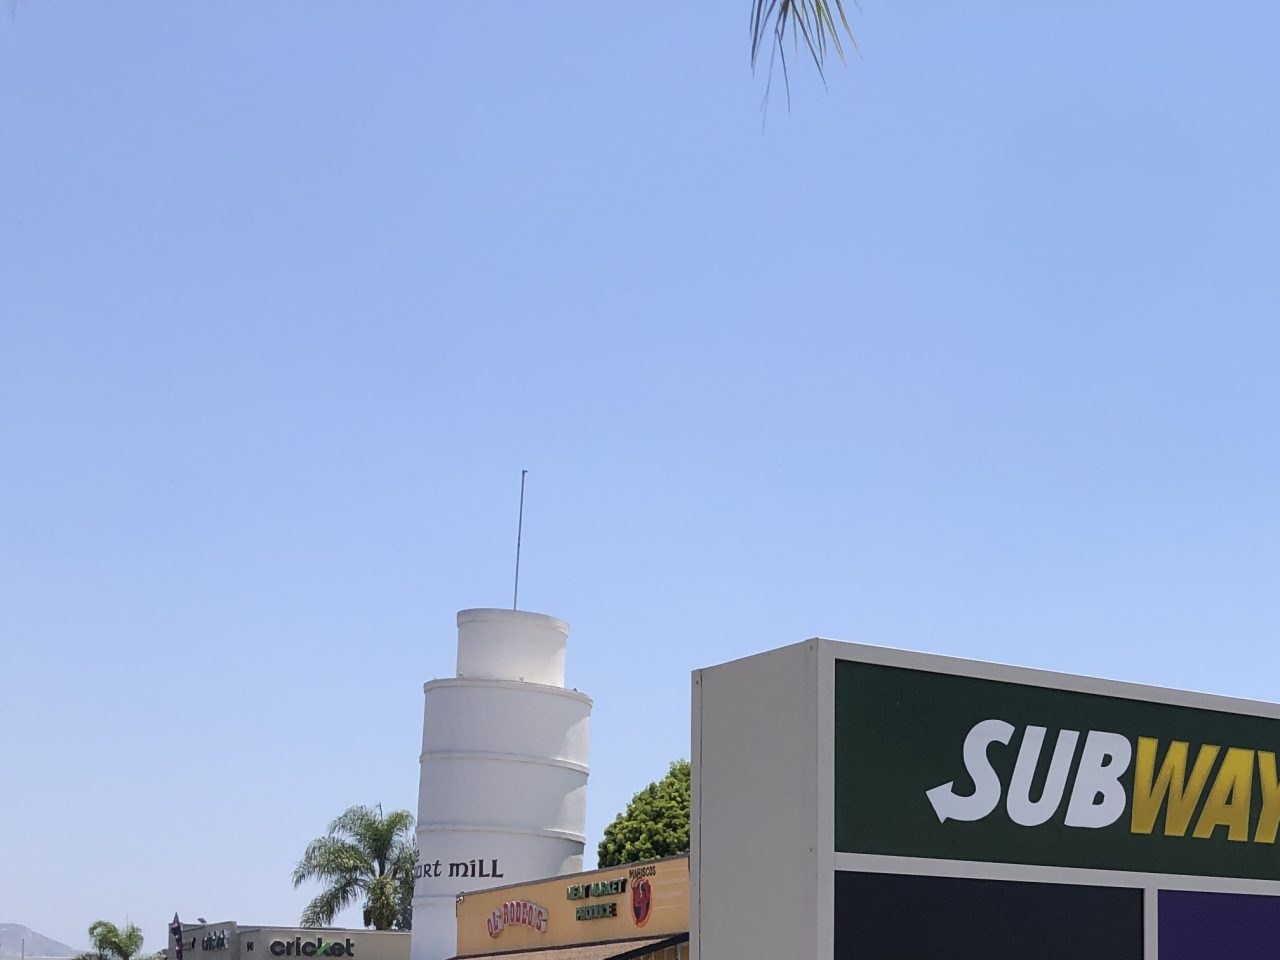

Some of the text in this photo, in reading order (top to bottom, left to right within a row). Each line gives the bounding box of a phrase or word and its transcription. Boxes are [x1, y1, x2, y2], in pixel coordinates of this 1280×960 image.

[629, 866, 656, 878] MARISCOS
[567, 877, 626, 900] MEAT MARKET
[576, 903, 616, 921] PRODUCE
[270, 937, 354, 957] cricket
